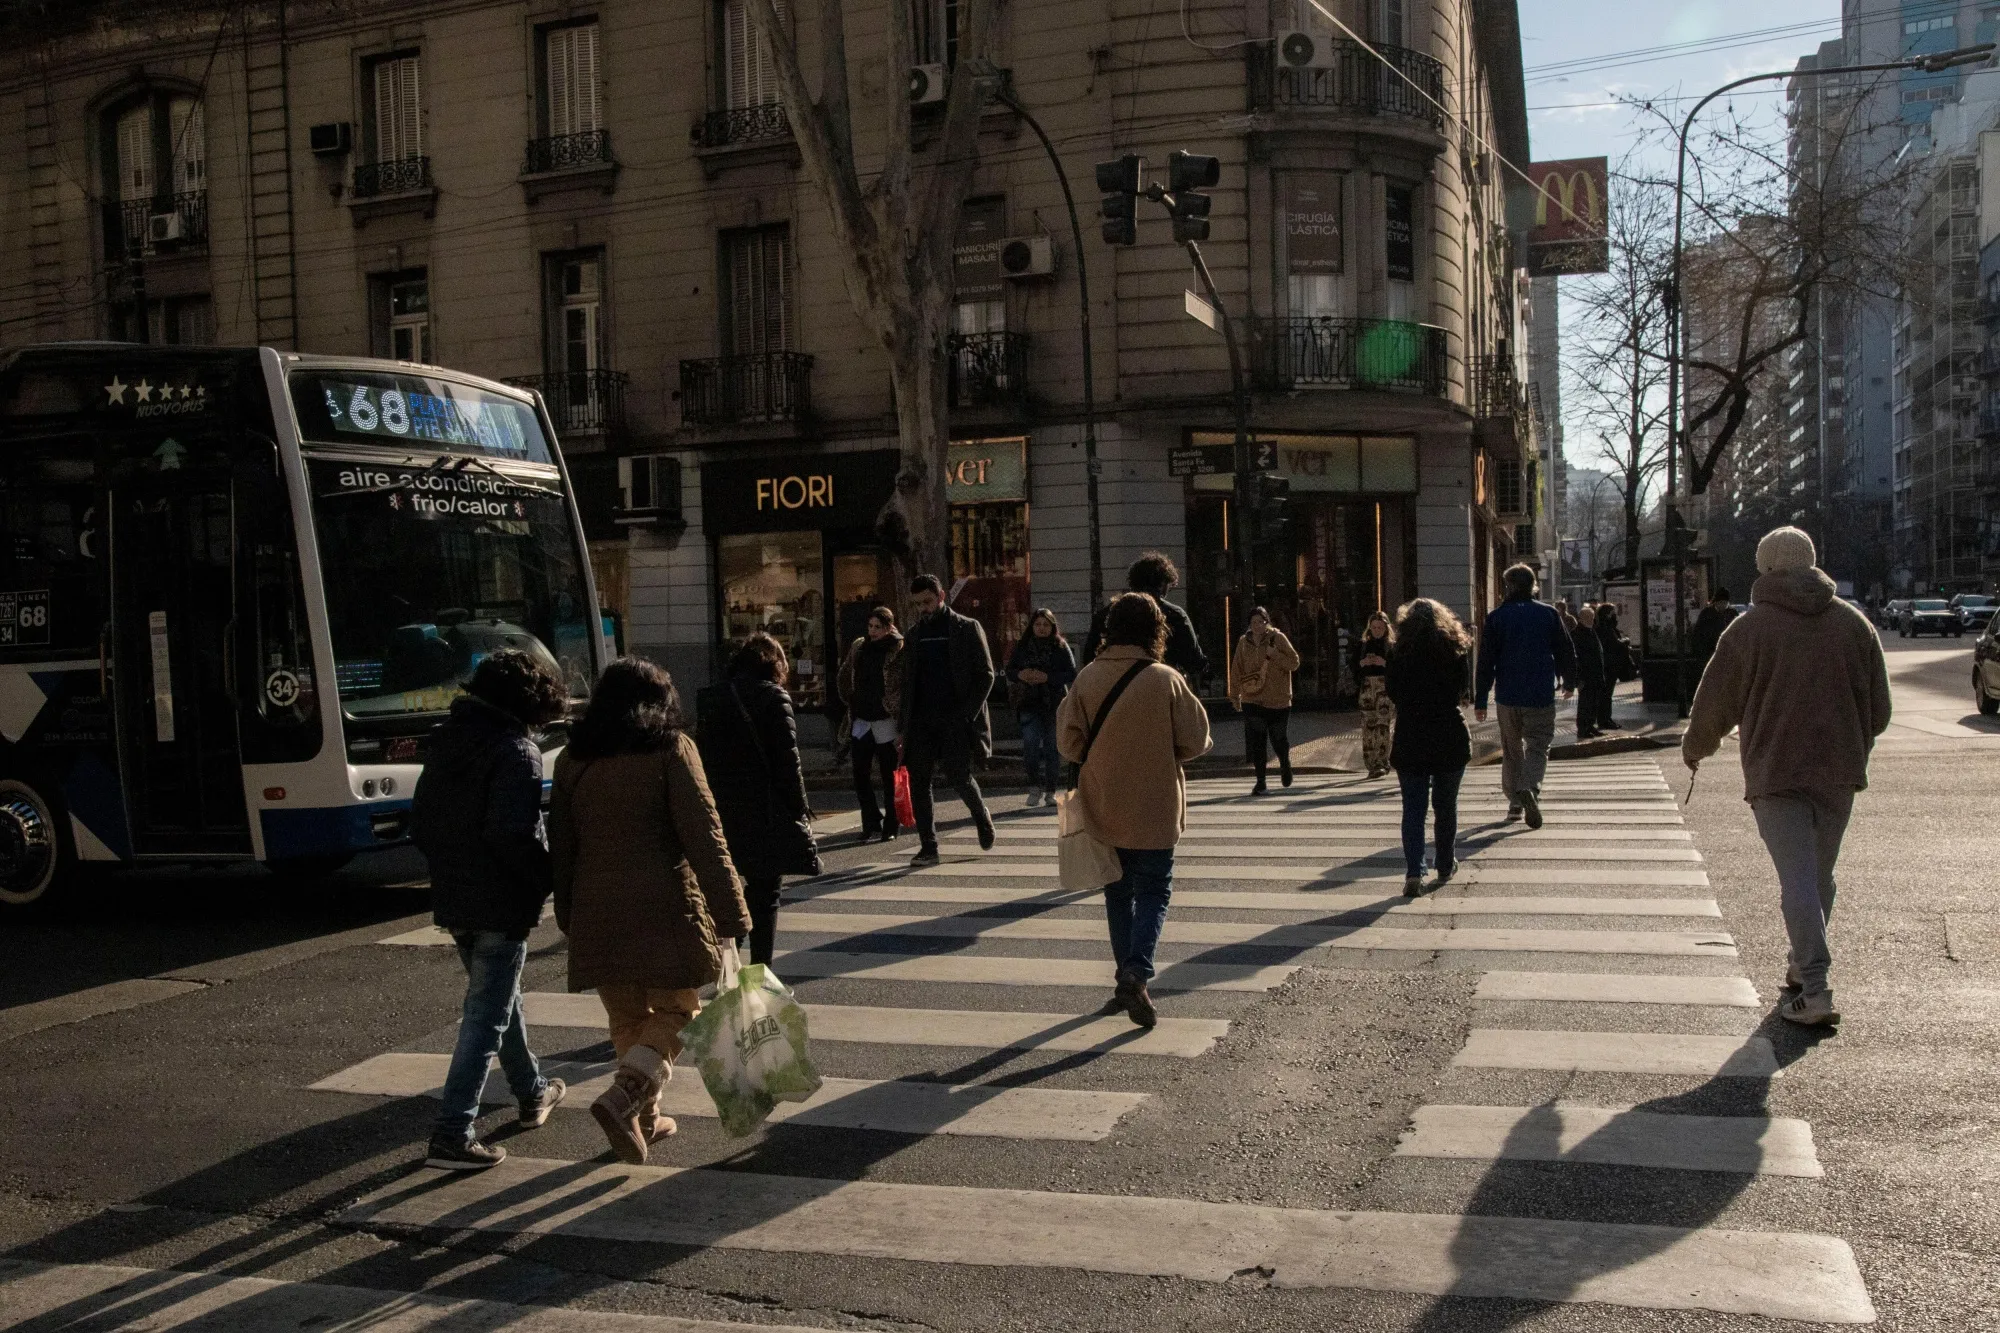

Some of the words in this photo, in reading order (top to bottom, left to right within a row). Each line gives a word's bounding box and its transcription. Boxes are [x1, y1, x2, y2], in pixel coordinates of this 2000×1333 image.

[136, 399, 206, 418] NUOVOBUS
[349, 385, 410, 435] 68
[1172, 449, 1203, 458] Avenida
[1172, 459, 1194, 467] Santa
[1195, 457, 1205, 465] Fe
[340, 467, 391, 488] aire
[756, 474, 834, 511] FIORI
[411, 495, 509, 516] frio/calor
[18, 593, 47, 602] LINEA
[20, 605, 46, 628] 68
[1, 626, 13, 642] 34
[273, 680, 293, 698] 34
